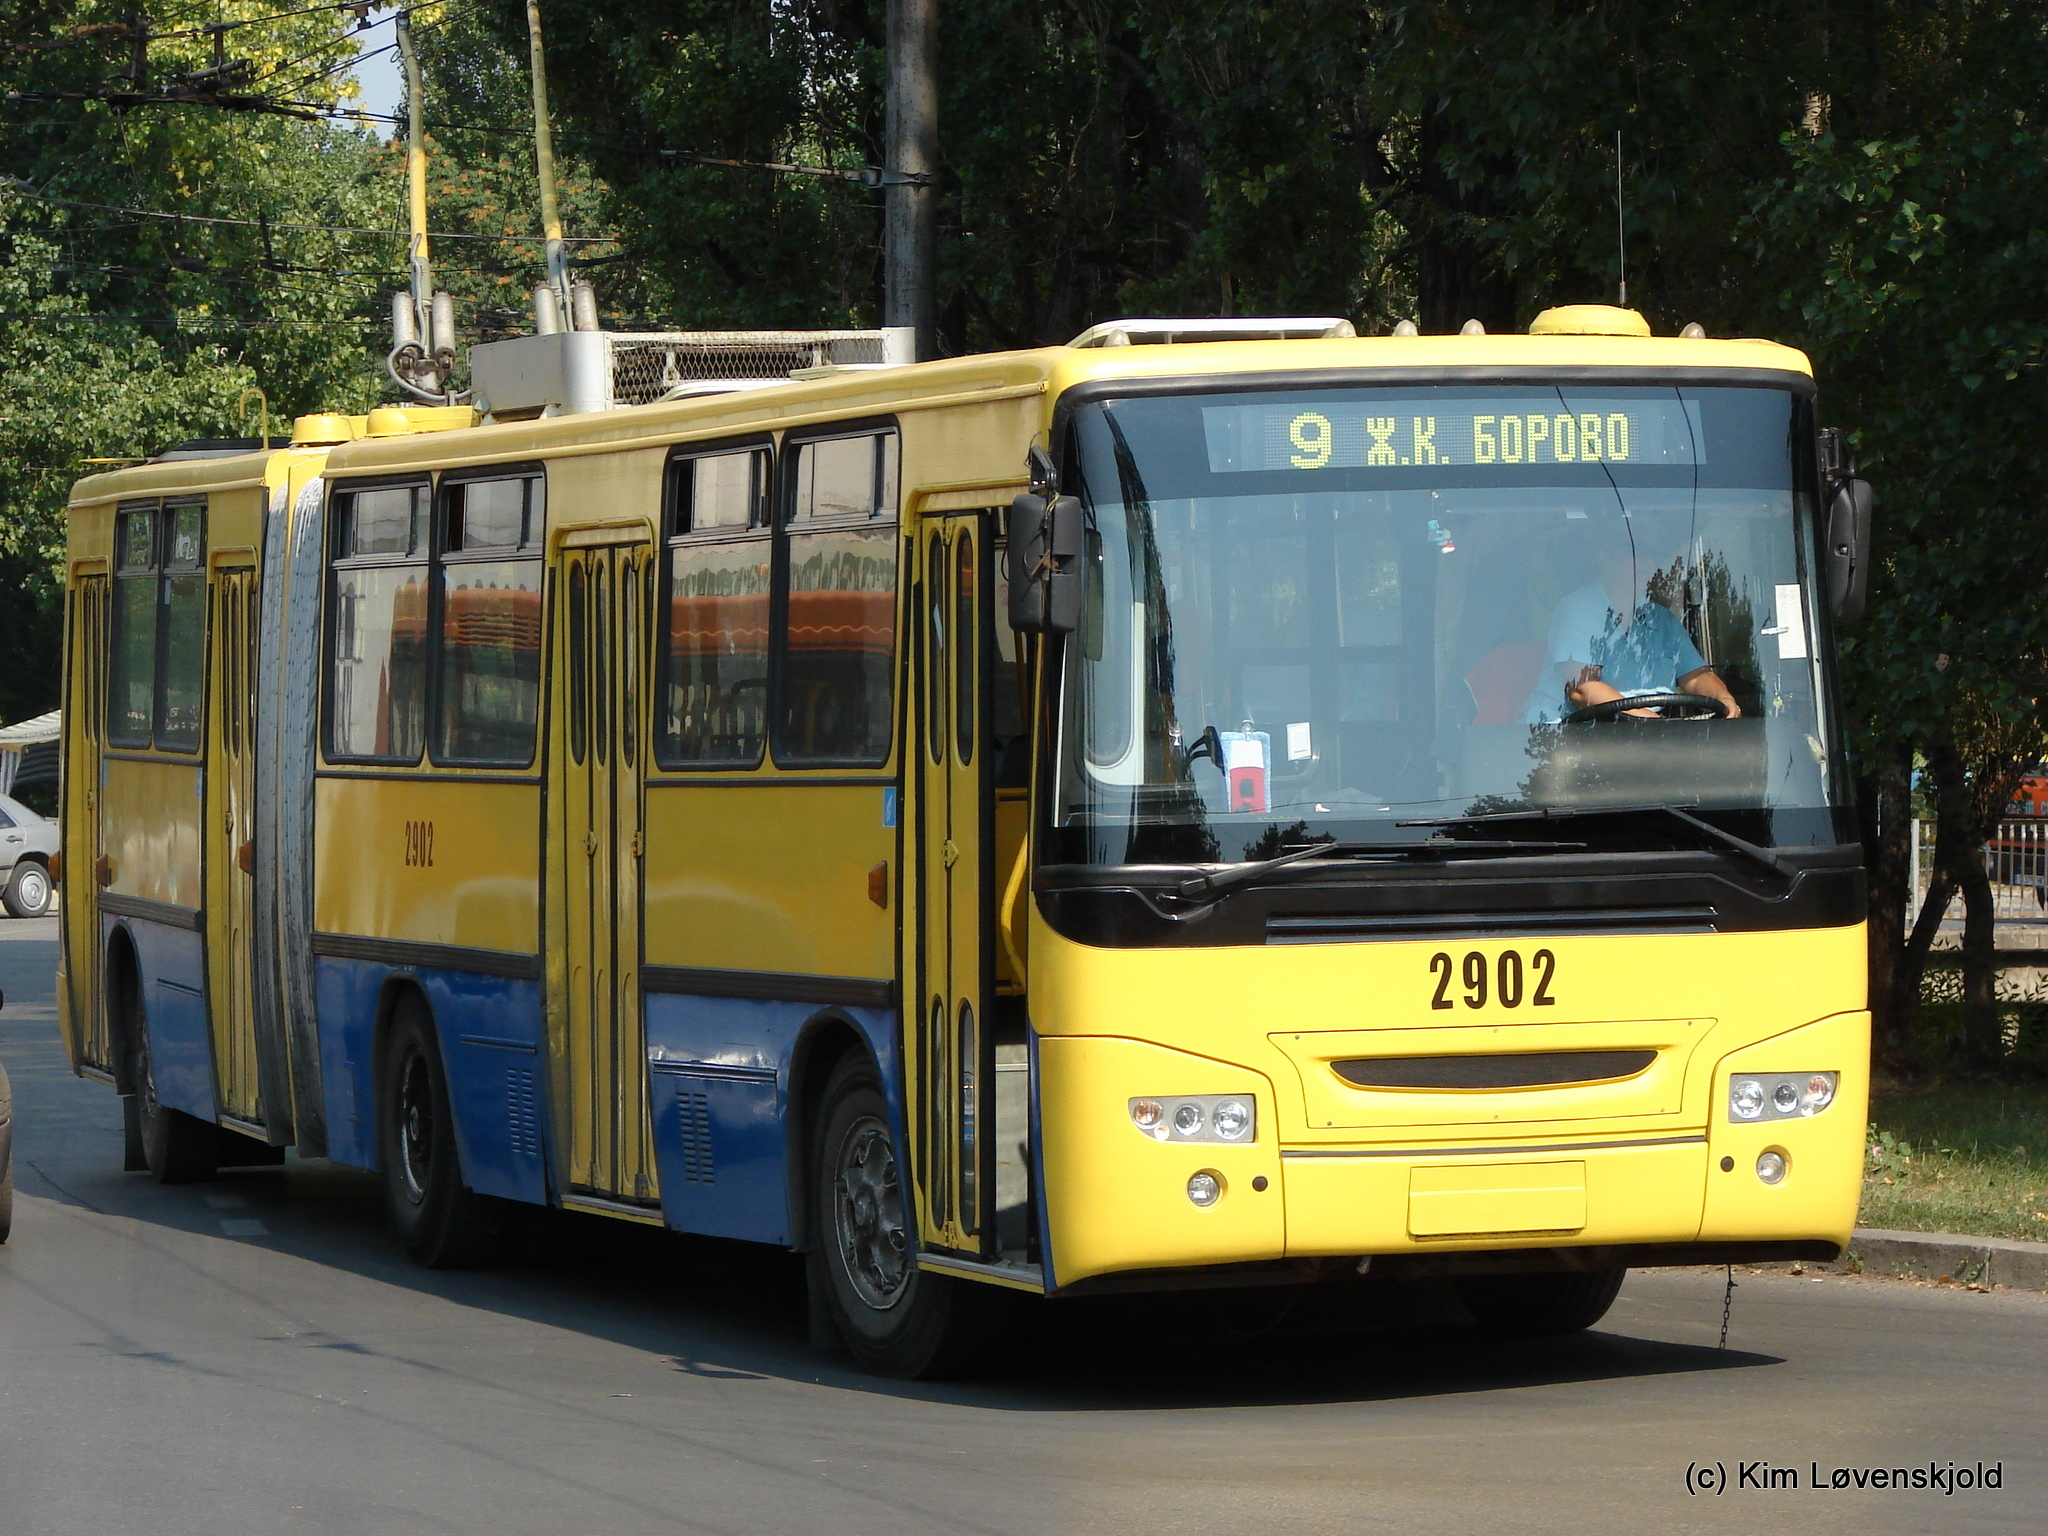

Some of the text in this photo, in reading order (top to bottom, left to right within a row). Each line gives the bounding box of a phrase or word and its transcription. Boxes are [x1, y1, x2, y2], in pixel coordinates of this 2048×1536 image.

[1288, 411, 1629, 470] 9 Ж.К. БОРОВО
[405, 820, 433, 868] 2902
[1429, 948, 1556, 1010] 2902
